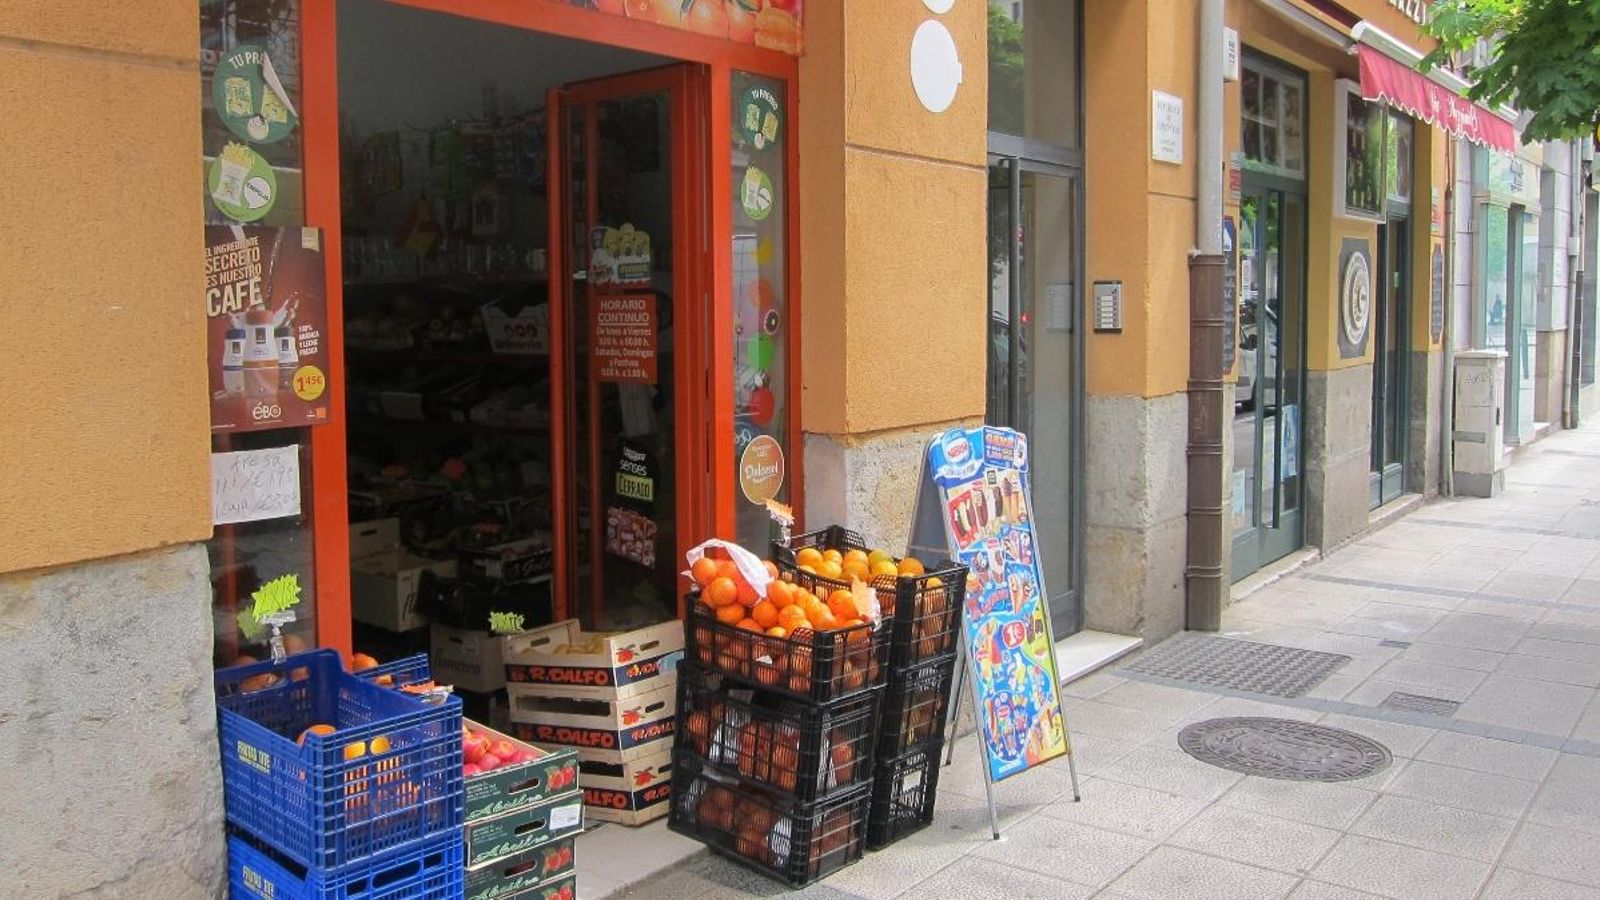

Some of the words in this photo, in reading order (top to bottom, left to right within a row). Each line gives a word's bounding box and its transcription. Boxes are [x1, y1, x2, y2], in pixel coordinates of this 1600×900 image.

[228, 53, 245, 69] TU
[206, 247, 260, 274] SECRETO
[219, 263, 262, 286] NUESTRO
[600, 299, 646, 311] HORARIO
[598, 311, 650, 322] CONTINUO
[619, 475, 650, 498] CERRADO
